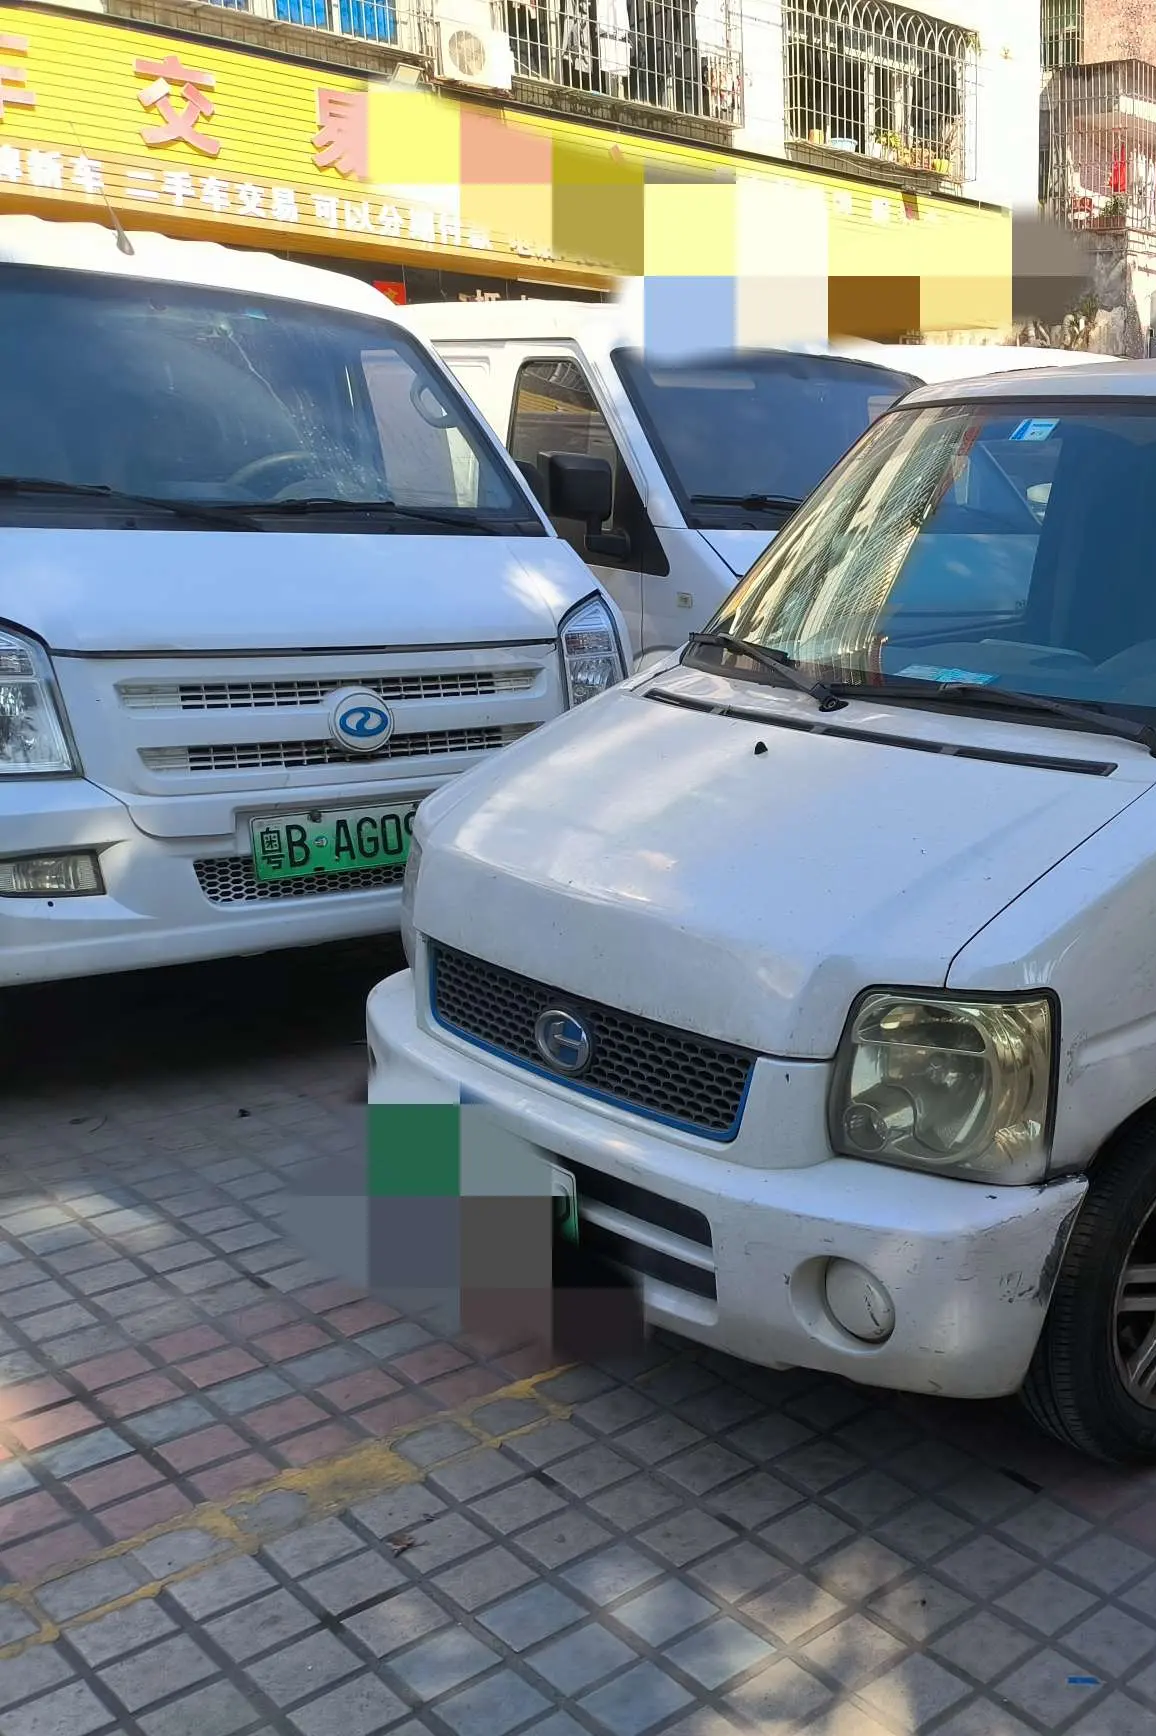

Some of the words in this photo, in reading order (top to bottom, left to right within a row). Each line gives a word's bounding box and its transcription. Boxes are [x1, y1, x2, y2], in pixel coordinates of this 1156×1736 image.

[126, 170, 299, 222] 二手车交易
